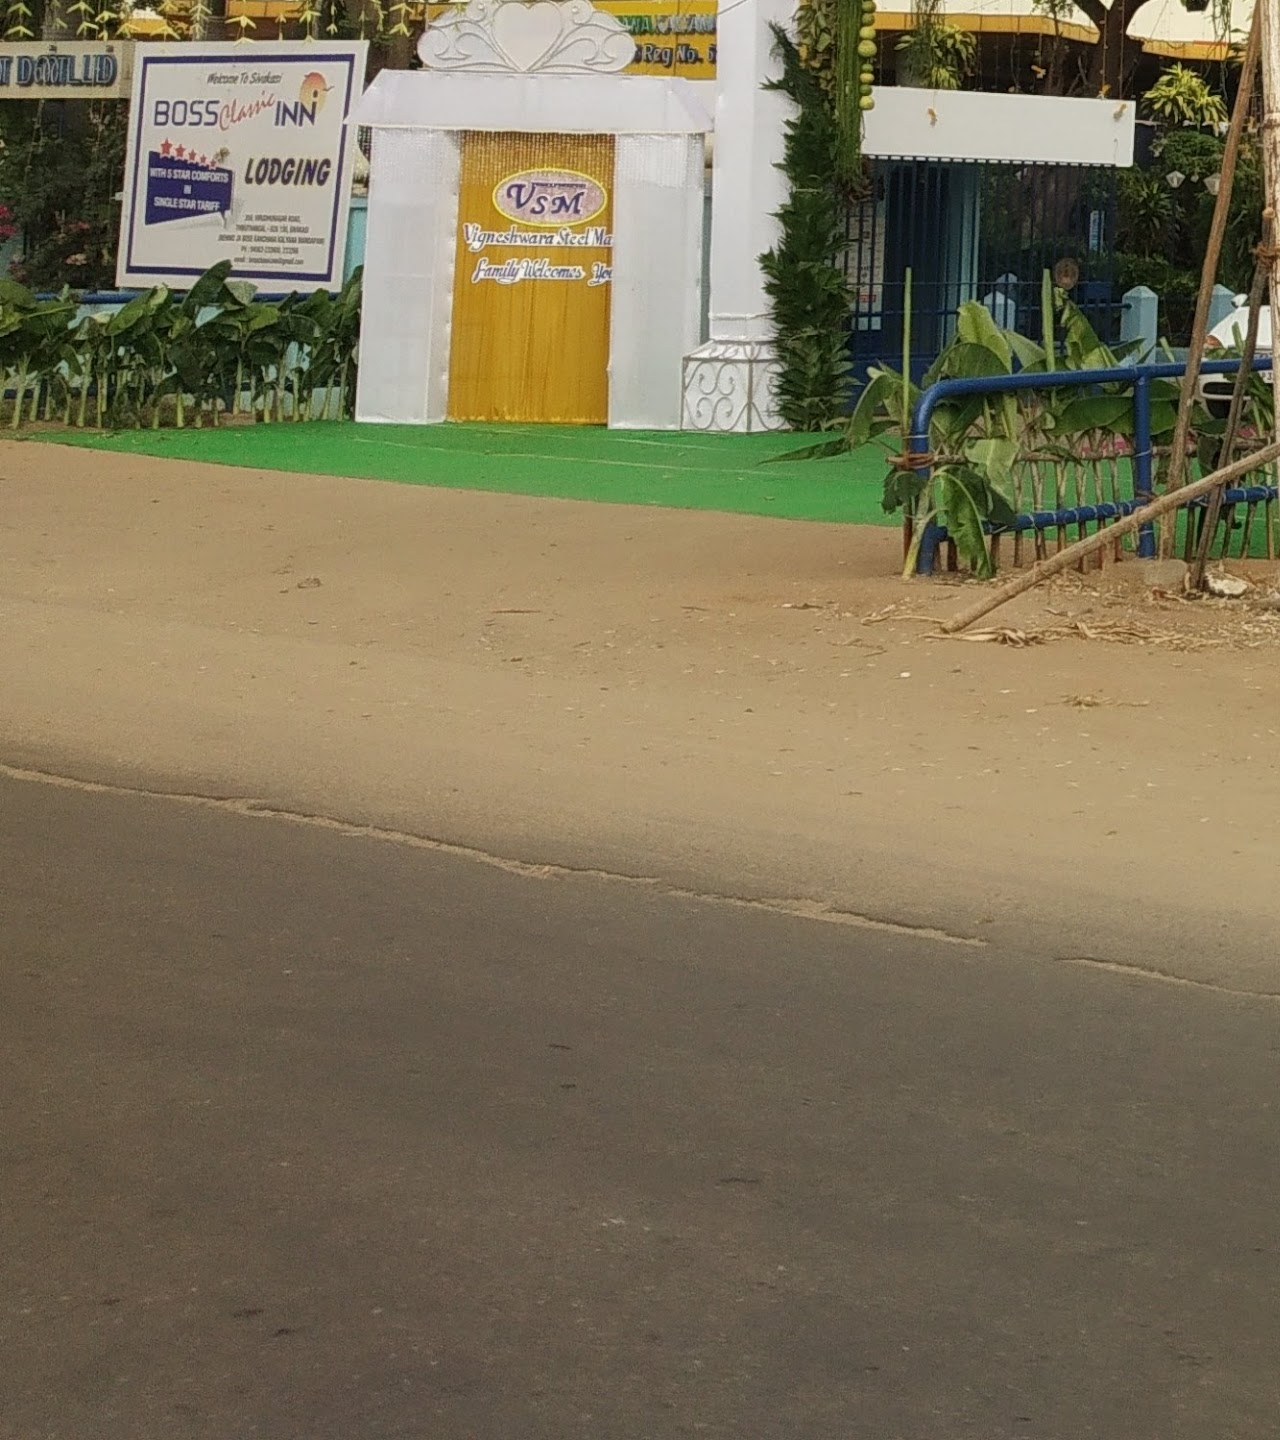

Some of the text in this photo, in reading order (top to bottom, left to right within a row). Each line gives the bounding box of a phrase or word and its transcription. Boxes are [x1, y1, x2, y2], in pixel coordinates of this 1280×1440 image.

[642, 43, 673, 68] Reg
[207, 72, 283, 84] Welcome To Sivakasi
[154, 90, 318, 131] BOSS Classic INN
[151, 167, 167, 178] WITH
[172, 170, 191, 181] STAR
[192, 171, 229, 184] COMFORTS
[244, 158, 331, 186] LODGING
[184, 184, 192, 195] IN
[506, 183, 585, 215] VSM
[154, 196, 220, 212] SINGLE STAR TARIFF
[464, 224, 554, 252] Vigneshwara
[556, 227, 589, 246] Steel
[472, 258, 519, 284] Family
[522, 260, 584, 279] Welcomes
